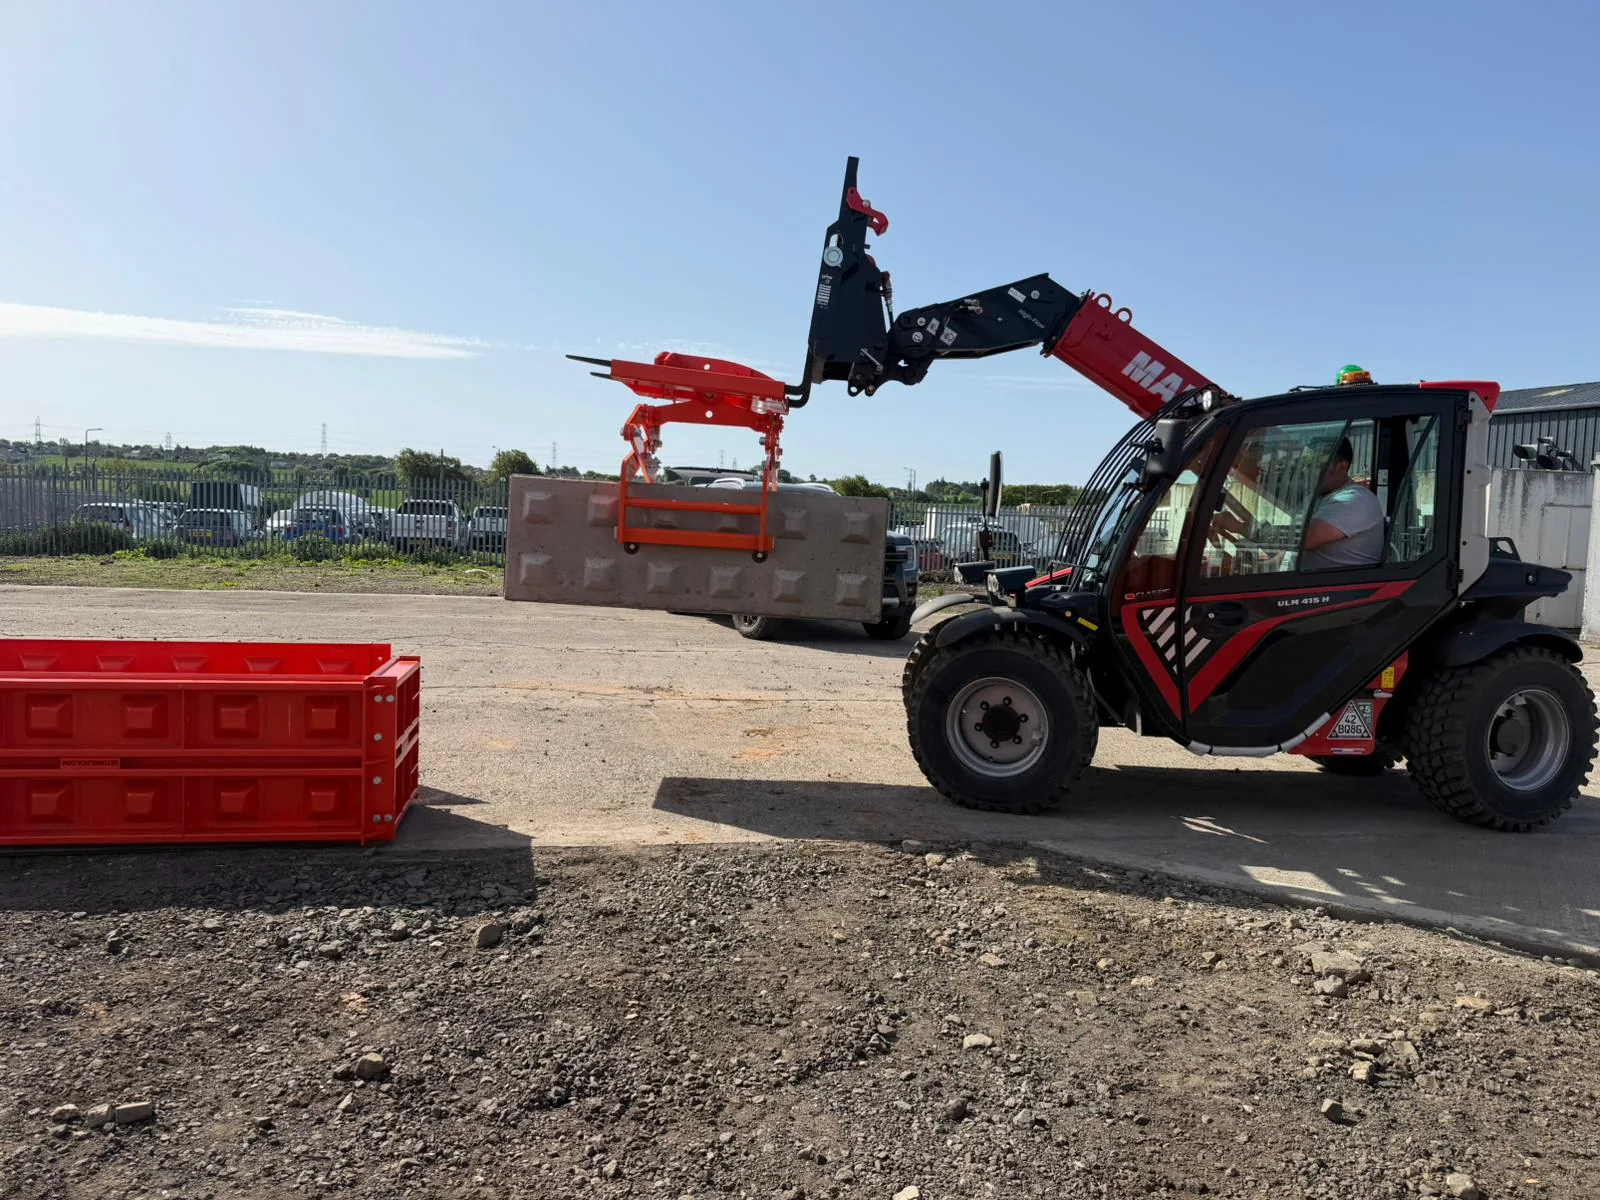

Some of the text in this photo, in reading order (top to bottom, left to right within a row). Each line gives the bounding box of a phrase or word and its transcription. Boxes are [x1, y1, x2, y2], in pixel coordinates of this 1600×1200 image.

[1277, 598, 1299, 607] ULM
[1321, 595, 1330, 603] H
[1345, 715, 1356, 725] 42
